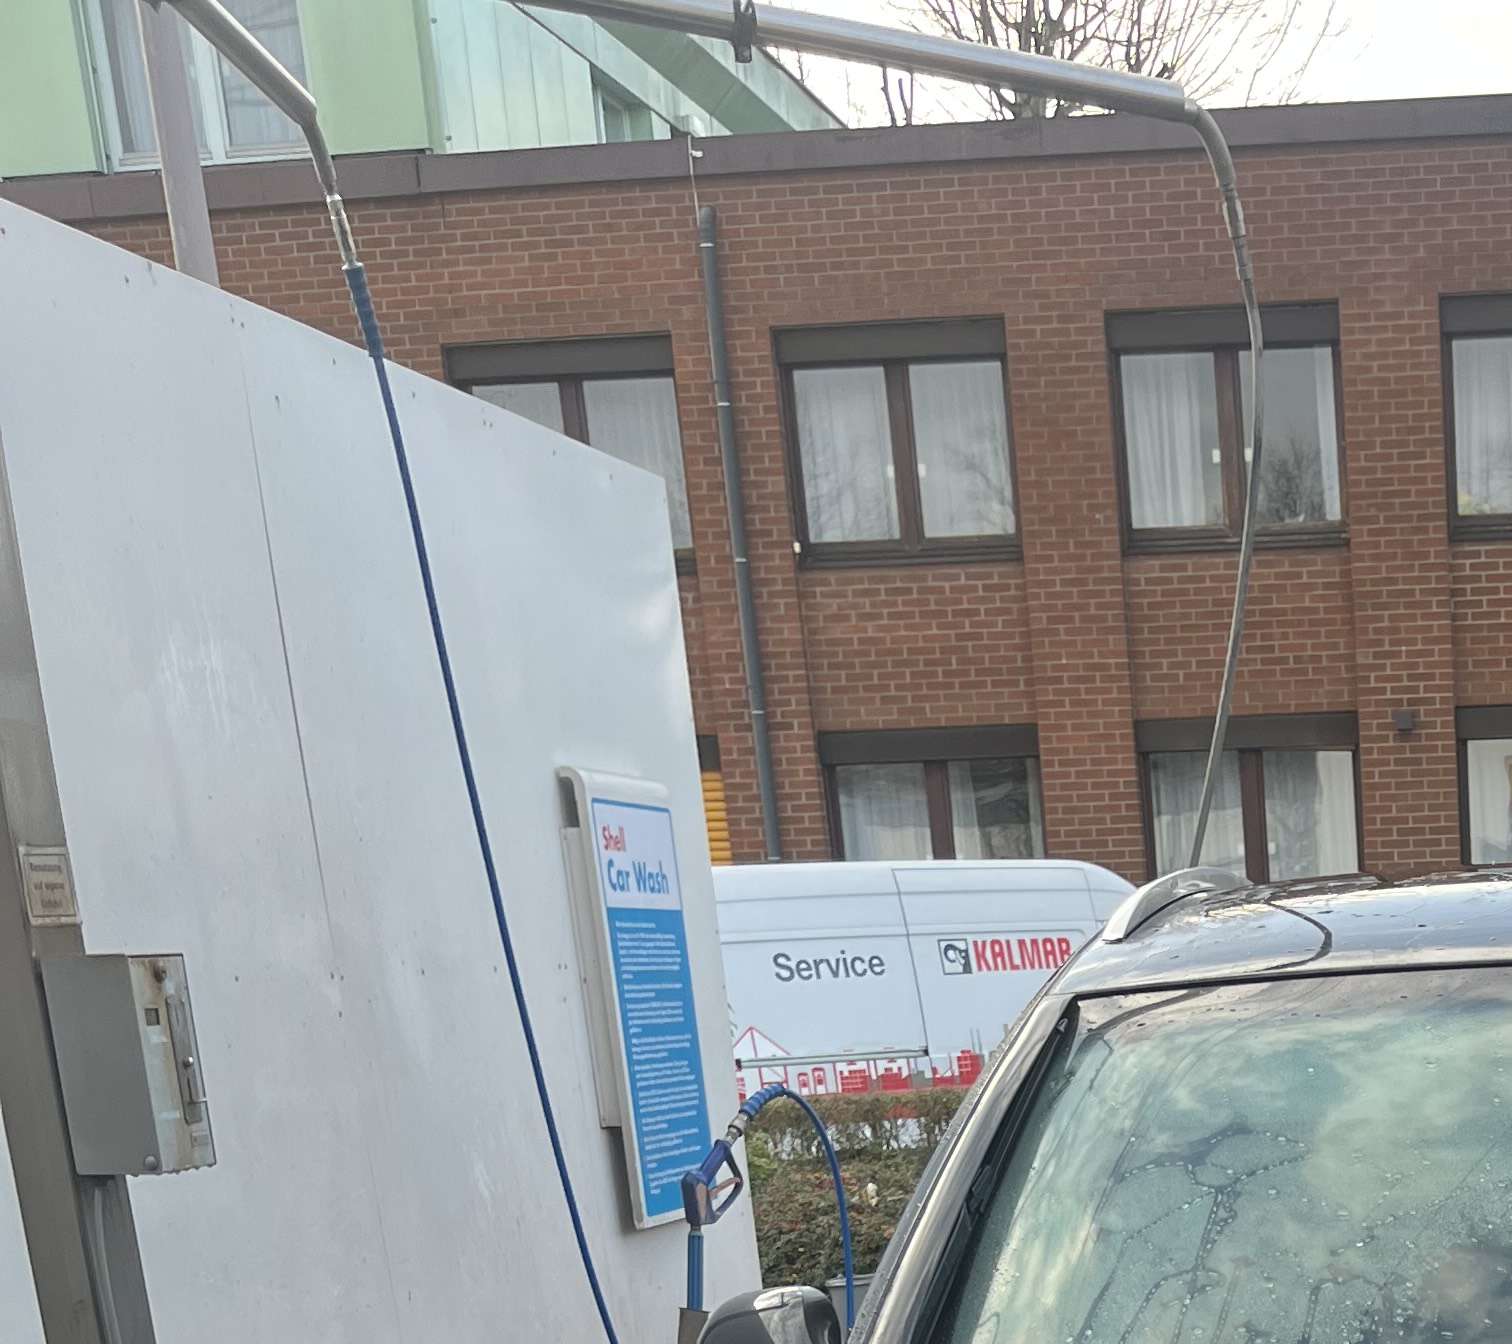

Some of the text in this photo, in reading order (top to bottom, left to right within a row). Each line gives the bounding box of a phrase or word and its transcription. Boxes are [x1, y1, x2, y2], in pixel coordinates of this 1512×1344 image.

[602, 824, 627, 852] Shell
[607, 858, 669, 894] Car Wash
[772, 949, 886, 983] Service
[972, 937, 1071, 972] KALMAR
